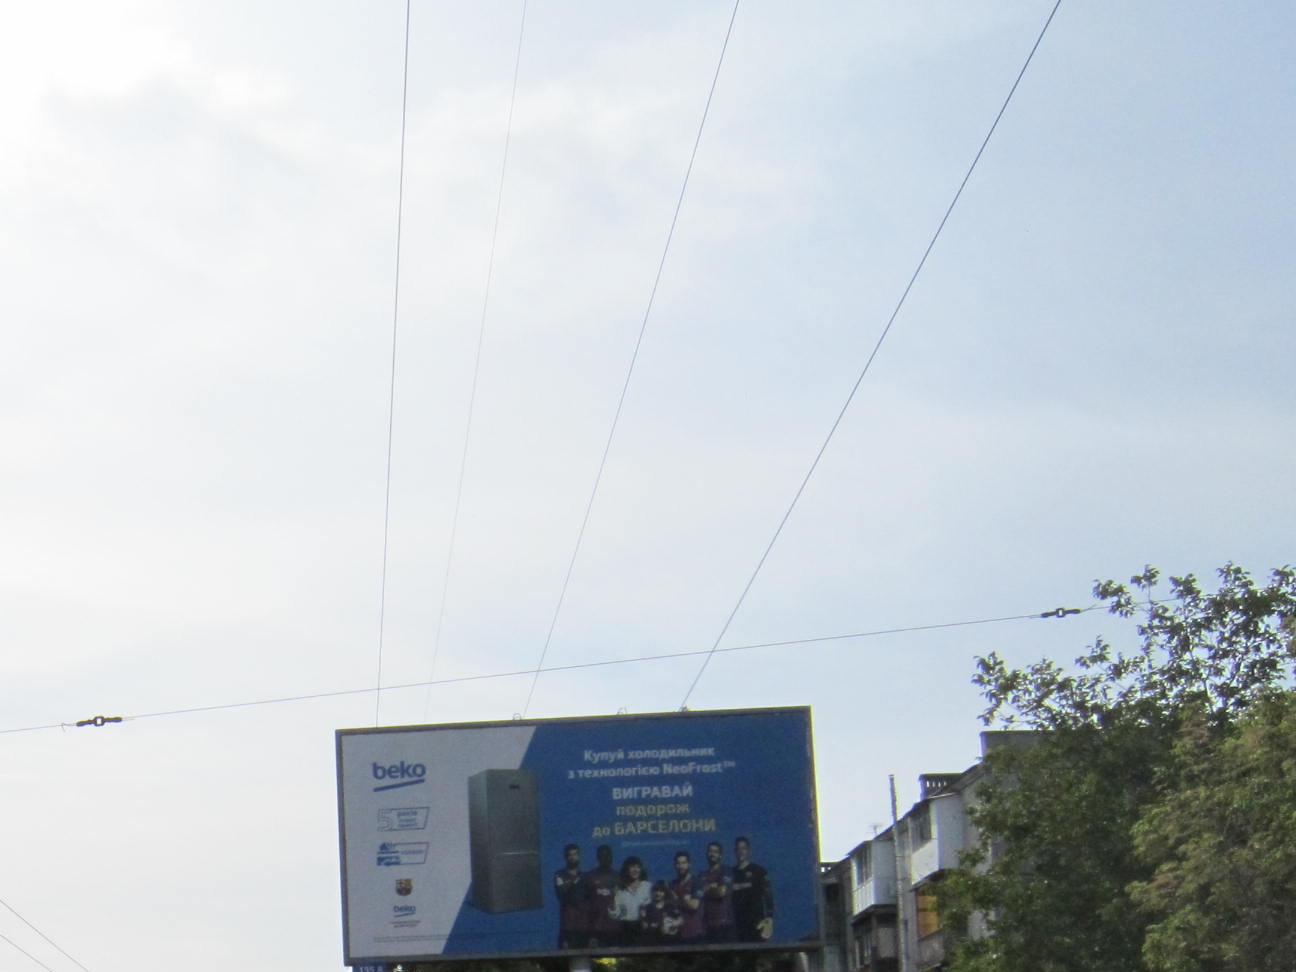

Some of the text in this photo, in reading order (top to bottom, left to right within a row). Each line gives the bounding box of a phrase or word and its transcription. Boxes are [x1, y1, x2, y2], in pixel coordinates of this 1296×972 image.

[584, 747, 715, 763] Купуй холодильник
[372, 761, 426, 780] beko
[578, 766, 659, 779] технологією
[612, 782, 693, 800] ВИГРАВАЙ
[616, 803, 690, 817] подорож
[592, 819, 716, 838] до БАРСЕЛОНИ
